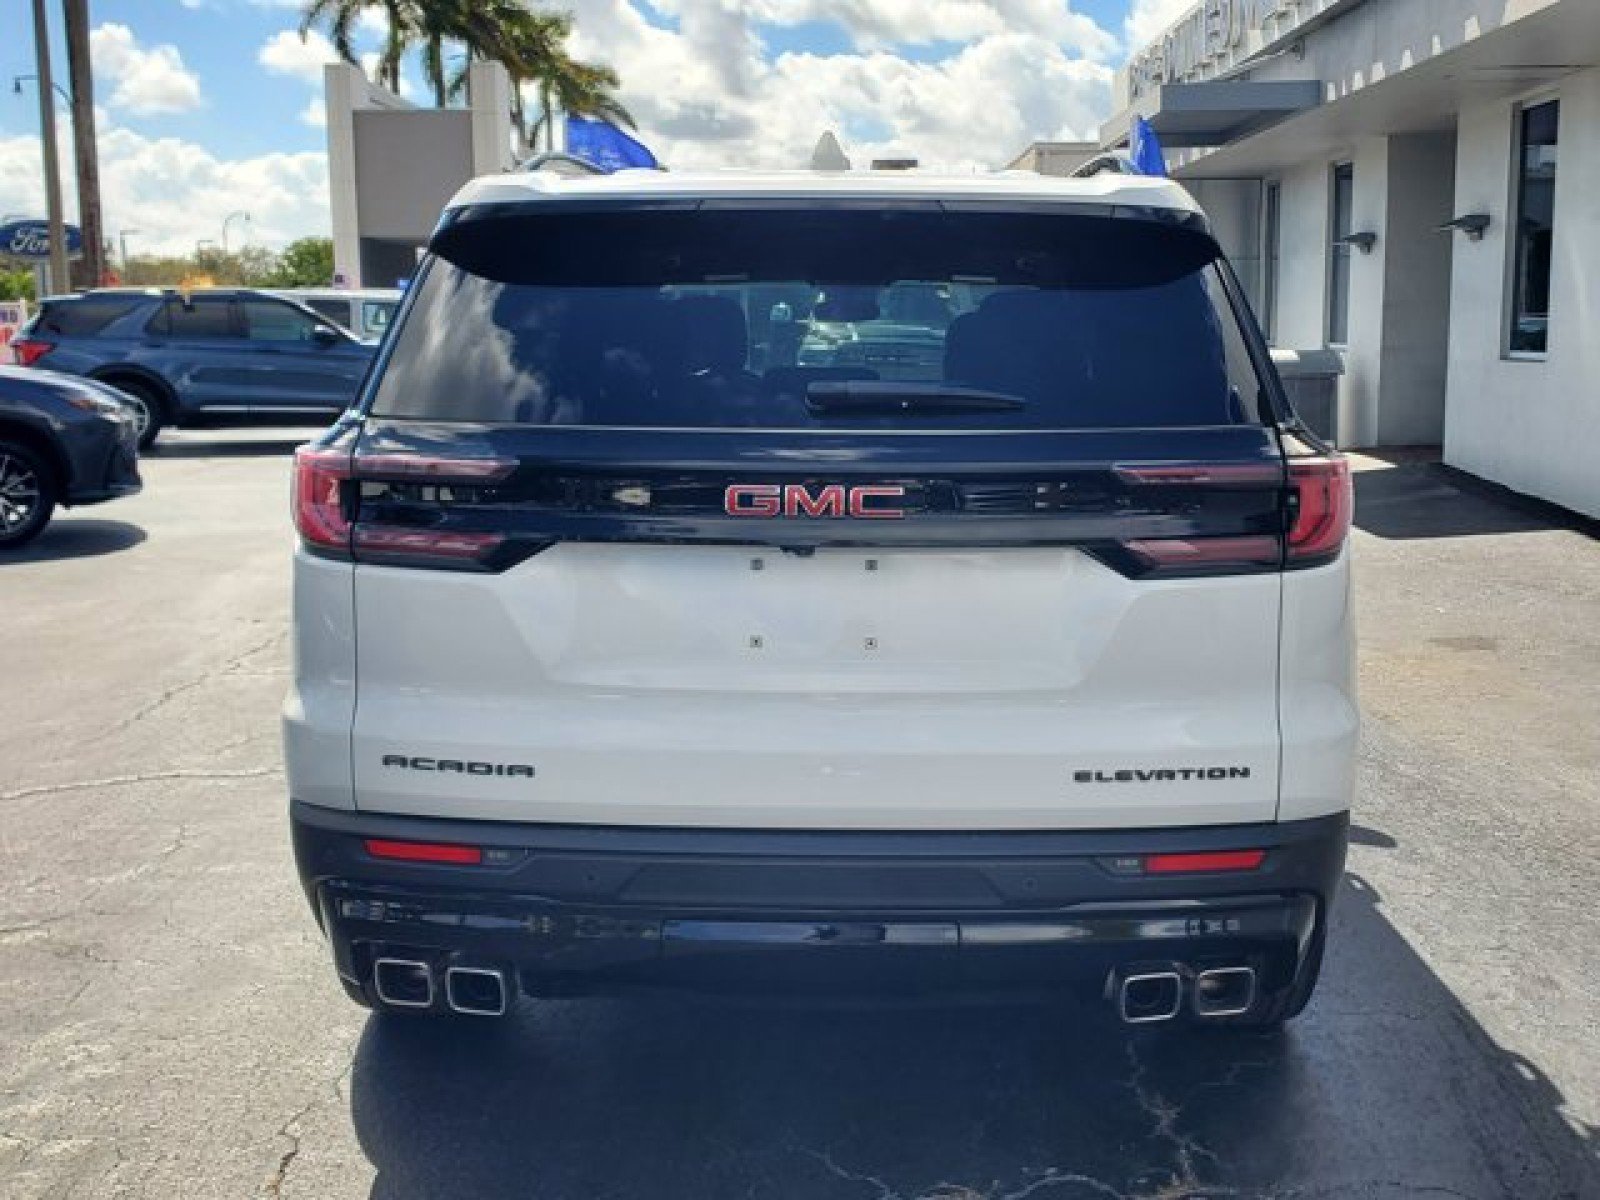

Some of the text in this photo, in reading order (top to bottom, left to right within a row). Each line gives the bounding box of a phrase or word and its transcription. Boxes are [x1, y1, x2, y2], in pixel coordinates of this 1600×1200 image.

[725, 484, 905, 520] GMC
[381, 754, 536, 779] ACADIA
[1073, 766, 1251, 783] ELEVATION
